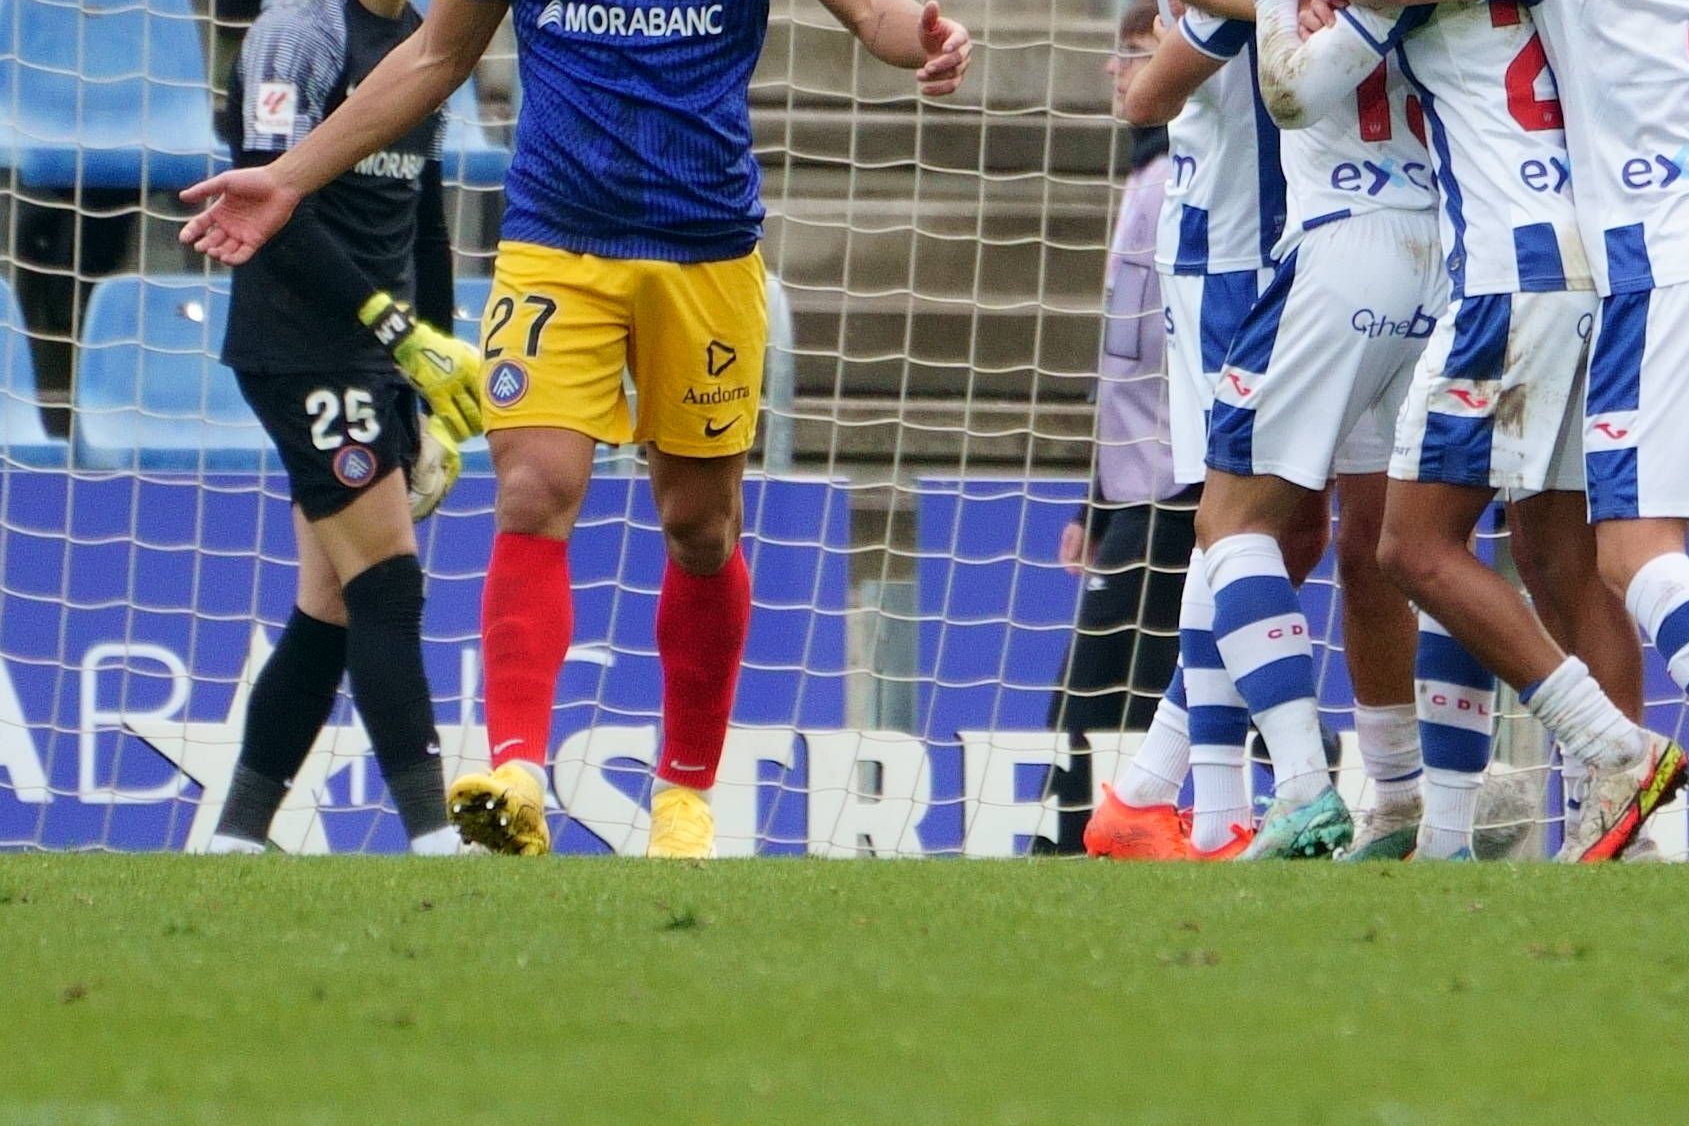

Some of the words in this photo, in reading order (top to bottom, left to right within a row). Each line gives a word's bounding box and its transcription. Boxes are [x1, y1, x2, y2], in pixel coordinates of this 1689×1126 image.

[565, 2, 724, 37] MORABANC
[484, 295, 557, 361] 27
[682, 384, 751, 405] Andorra
[305, 389, 381, 451] 25
